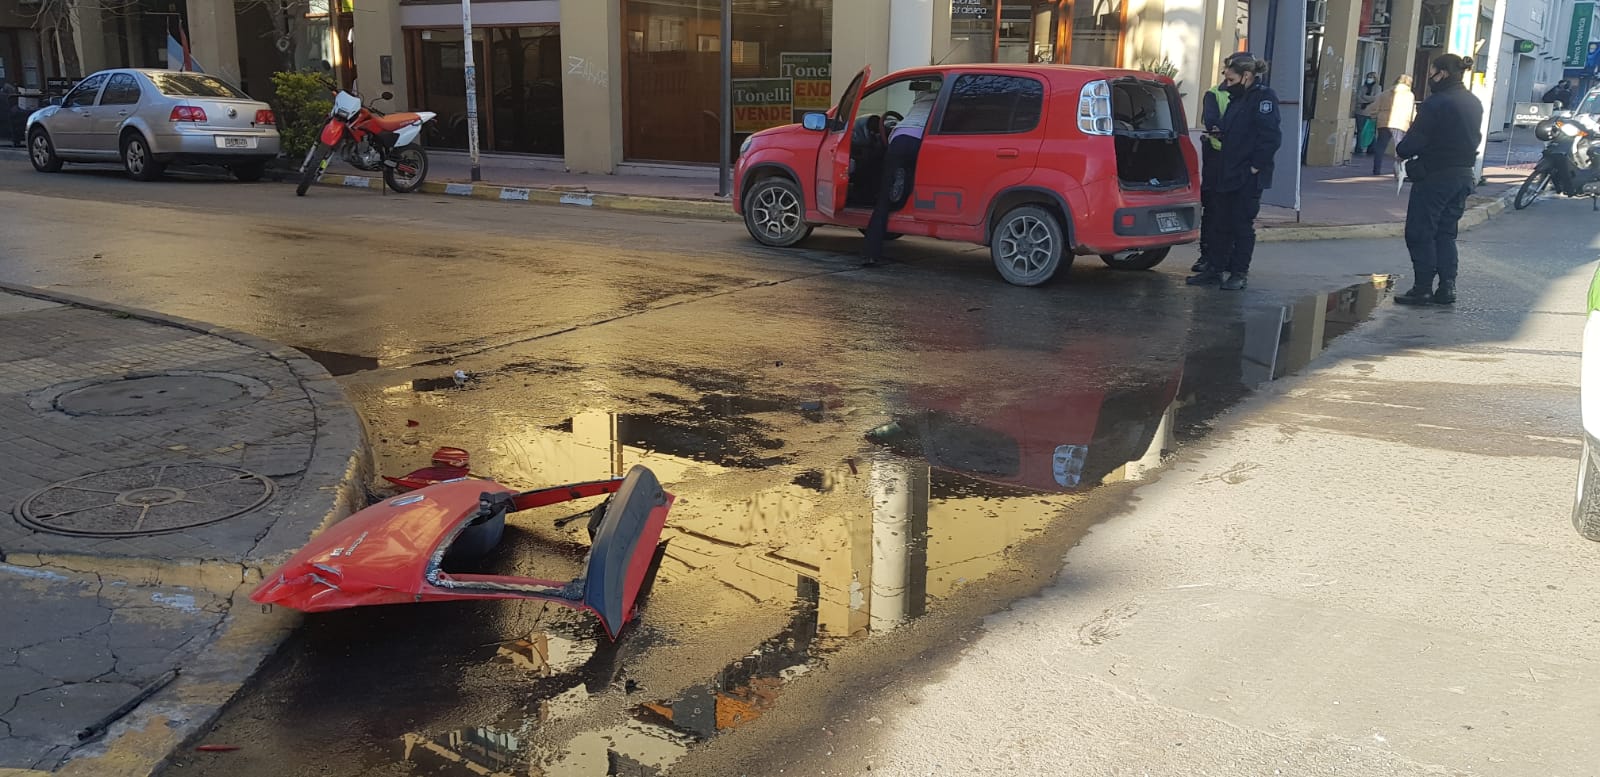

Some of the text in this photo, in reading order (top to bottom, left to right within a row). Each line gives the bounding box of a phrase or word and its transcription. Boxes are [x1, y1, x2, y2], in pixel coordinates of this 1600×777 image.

[1571, 17, 1586, 65] Banco Provincia
[782, 63, 832, 77] Tonel
[735, 88, 791, 102] Tonelli
[795, 81, 831, 97] END
[735, 106, 791, 121] VENDE
